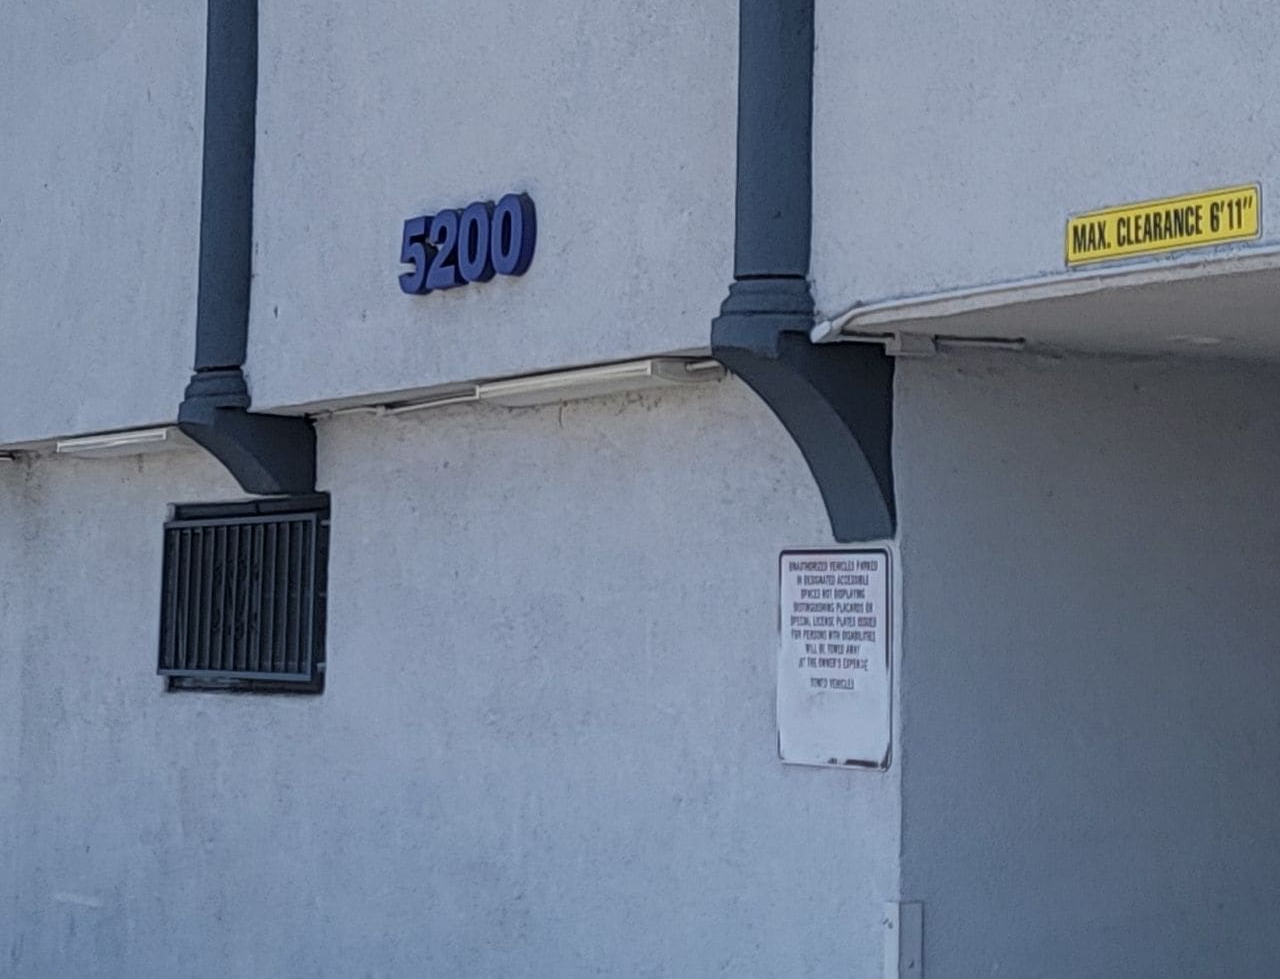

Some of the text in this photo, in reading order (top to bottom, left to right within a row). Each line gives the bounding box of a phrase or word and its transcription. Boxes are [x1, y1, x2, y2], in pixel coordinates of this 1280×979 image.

[398, 192, 538, 296] 5200
[1072, 196, 1254, 255] MAX. CLEARANCE 6'11"
